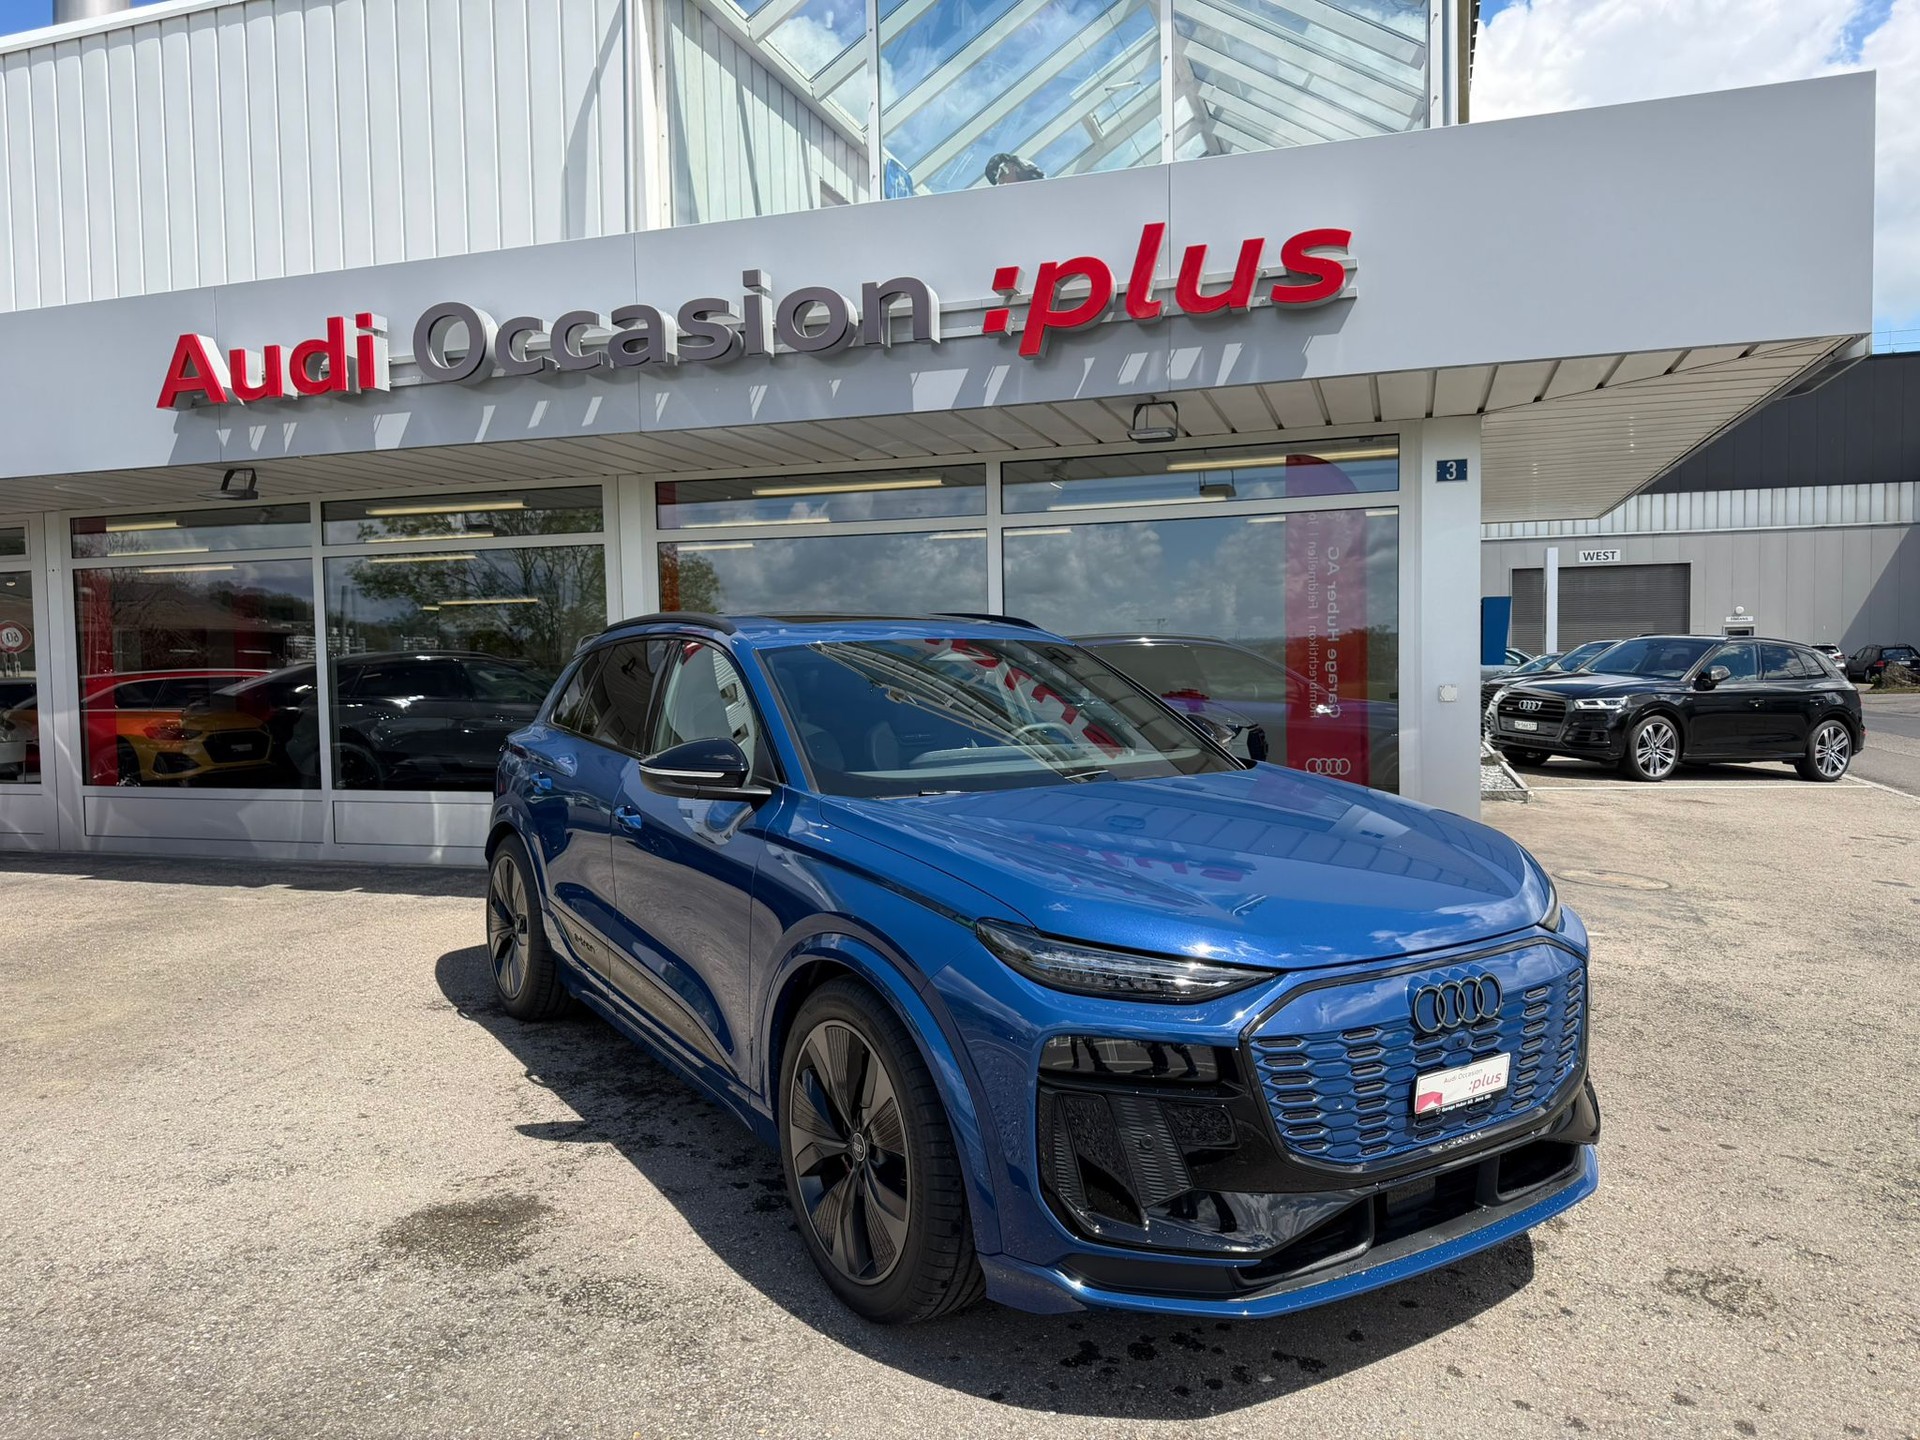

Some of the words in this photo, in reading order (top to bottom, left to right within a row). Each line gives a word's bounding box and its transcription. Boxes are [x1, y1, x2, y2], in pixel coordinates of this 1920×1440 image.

[157, 312, 385, 410] Audi
[412, 269, 938, 385] Occasion
[1446, 461, 1457, 480] 3
[1583, 551, 1617, 561] WEST
[1443, 1076, 1457, 1084] Audi
[1458, 1068, 1483, 1080] Occasion
